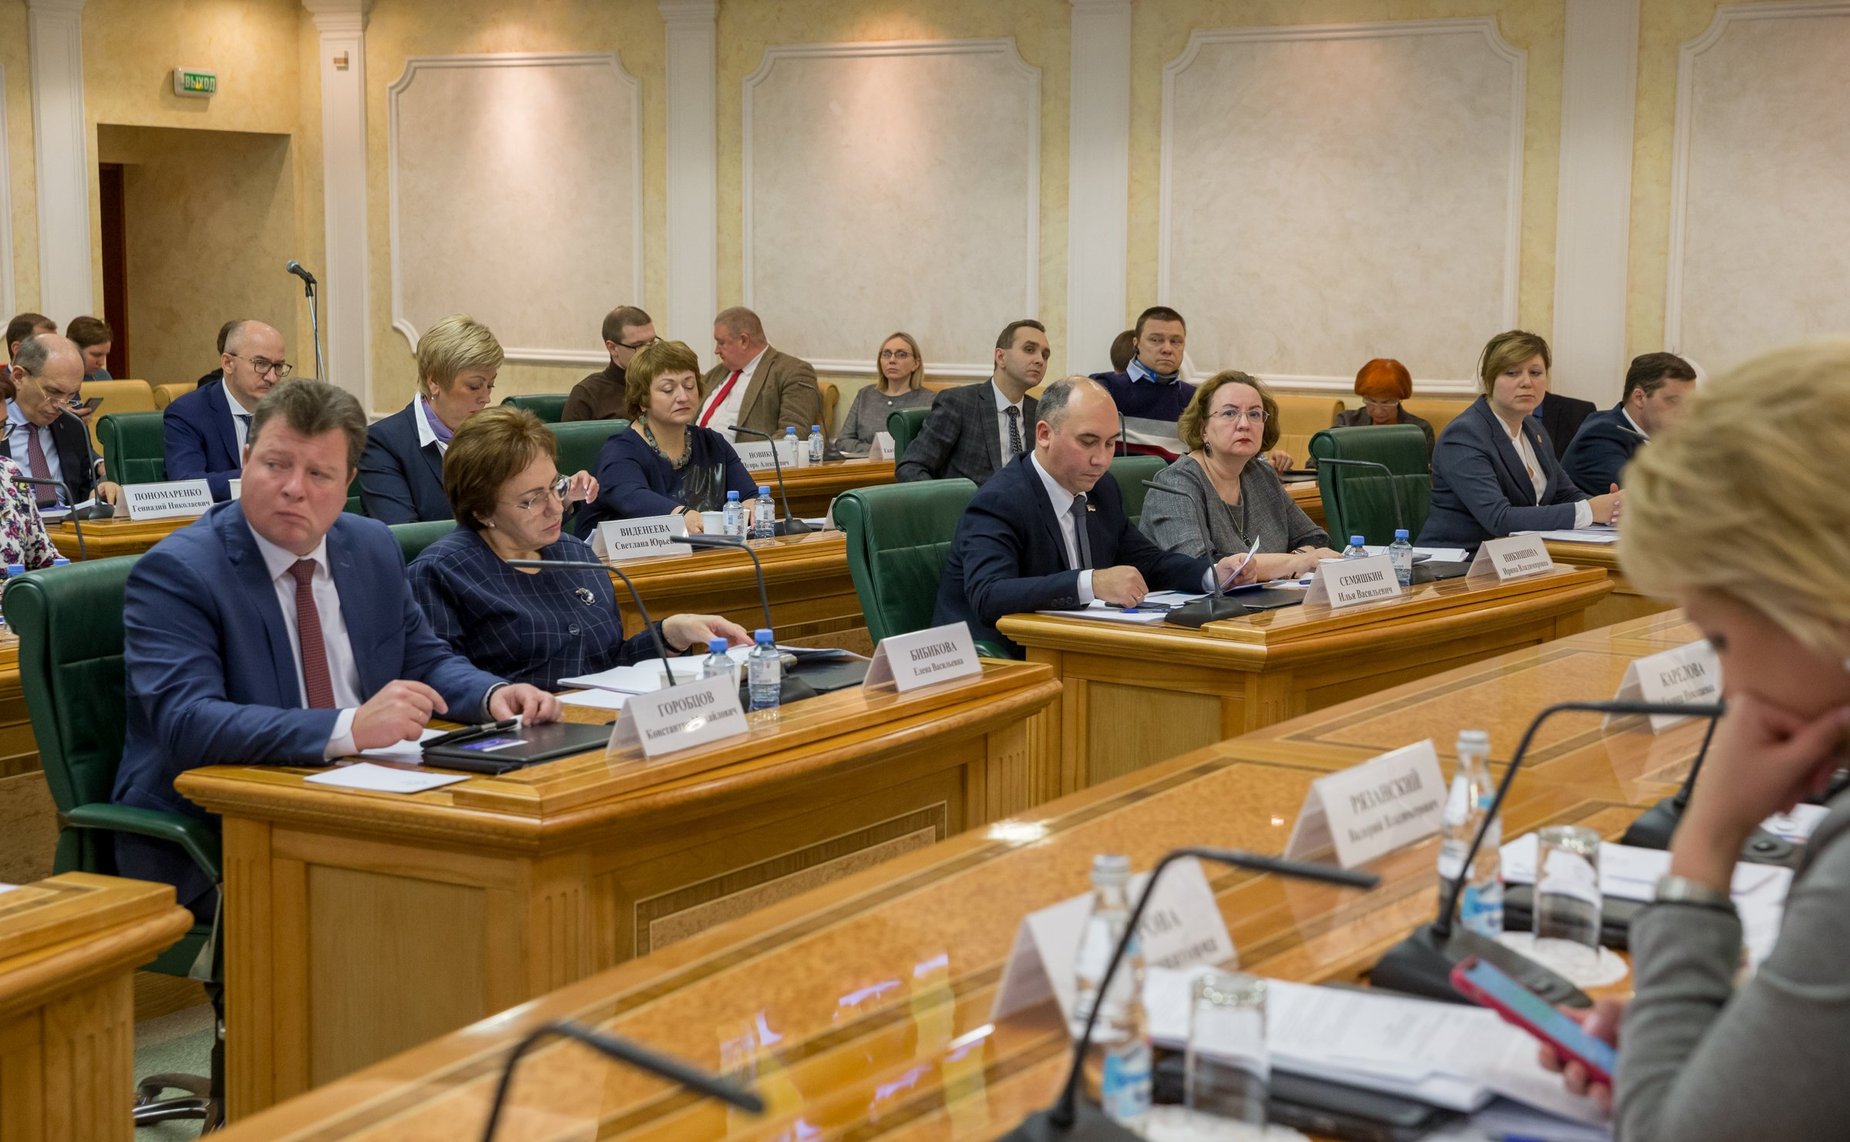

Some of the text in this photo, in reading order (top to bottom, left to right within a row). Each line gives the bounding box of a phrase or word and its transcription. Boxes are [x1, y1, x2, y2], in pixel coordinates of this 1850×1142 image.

[185, 75, 216, 93] ВЫХОД
[134, 488, 202, 501] ПОНОМАРЕНКО
[132, 500, 210, 512] Геннадий Николаевич
[620, 524, 671, 537] ВИДЕНЕЕВА
[615, 541, 649, 550] Светлана
[1502, 548, 1539, 563] НИКИШИНА
[1339, 571, 1384, 587] СЕМЯШКИН
[1338, 586, 1393, 602] Илья Васильевич
[910, 641, 958, 661] БИБИКОВА
[913, 658, 964, 677] Елена Васильевна
[1659, 662, 1705, 687] КАРЕЛОВА
[657, 691, 715, 717] ГОРОБЦОВ
[1350, 768, 1423, 814] РЯЗАНСКИЙ
